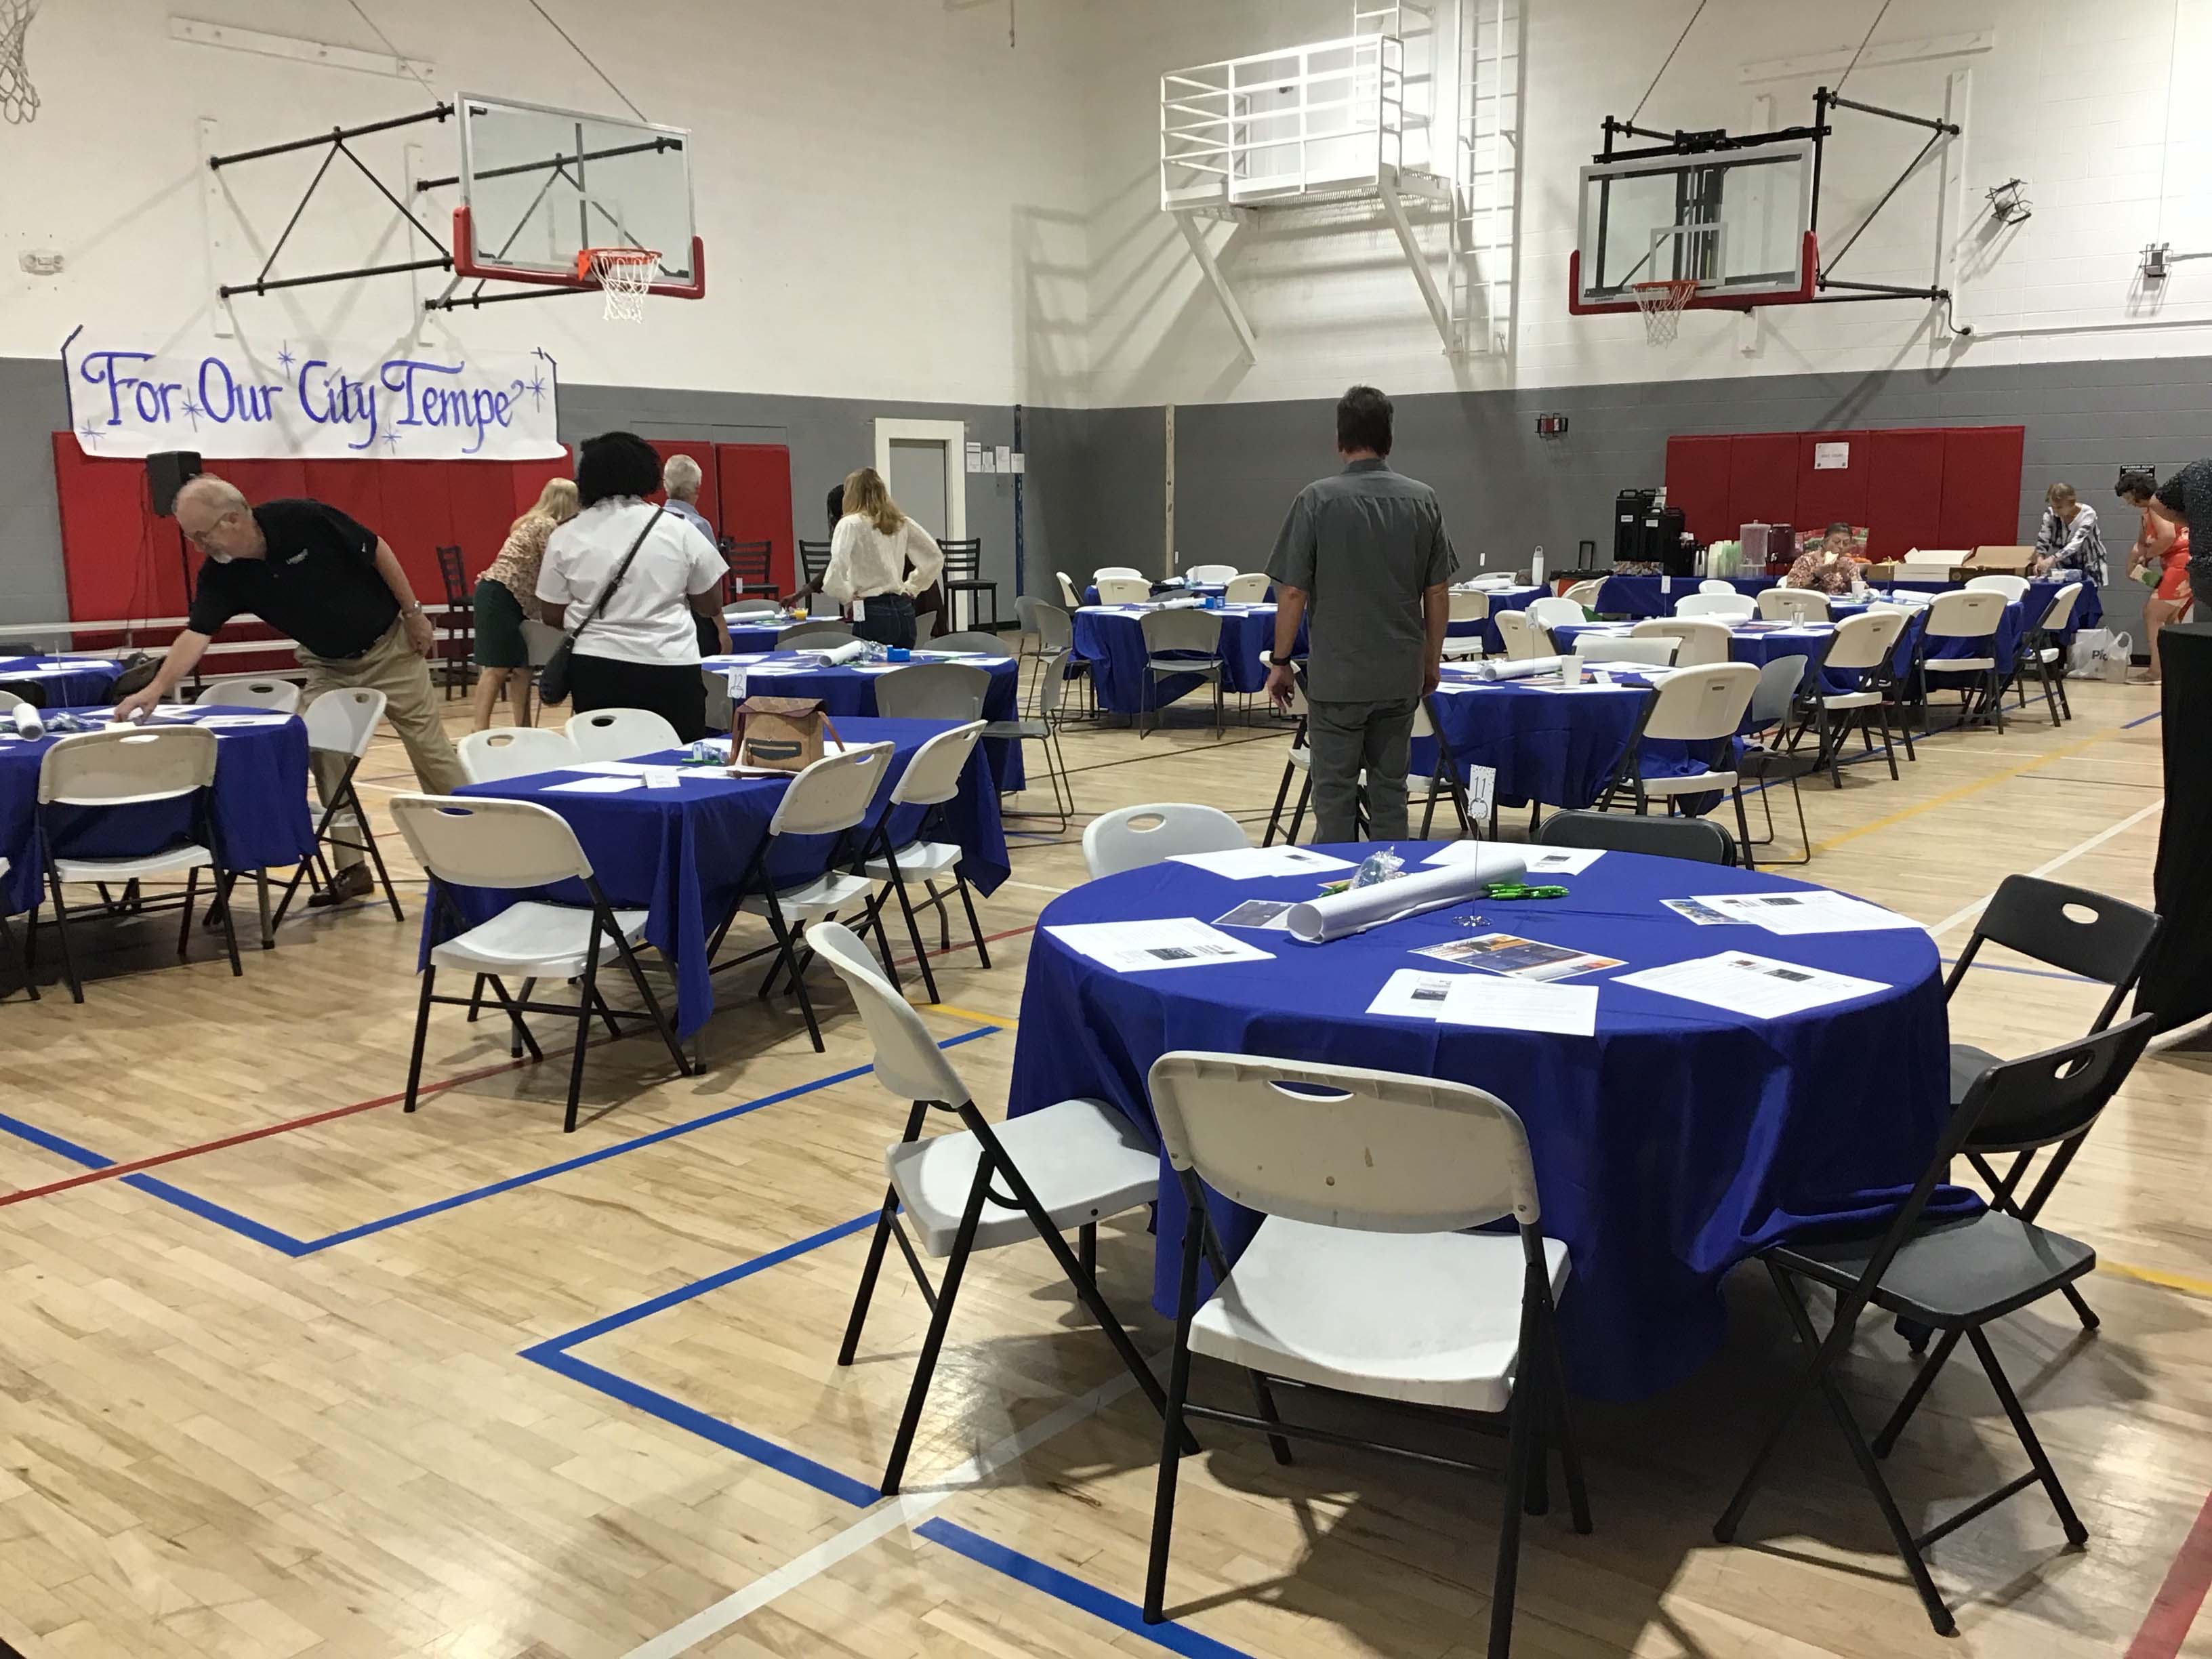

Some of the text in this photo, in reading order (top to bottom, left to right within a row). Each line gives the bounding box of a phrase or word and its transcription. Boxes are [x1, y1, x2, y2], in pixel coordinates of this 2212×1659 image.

[81, 351, 525, 454] For Our City Tempe
